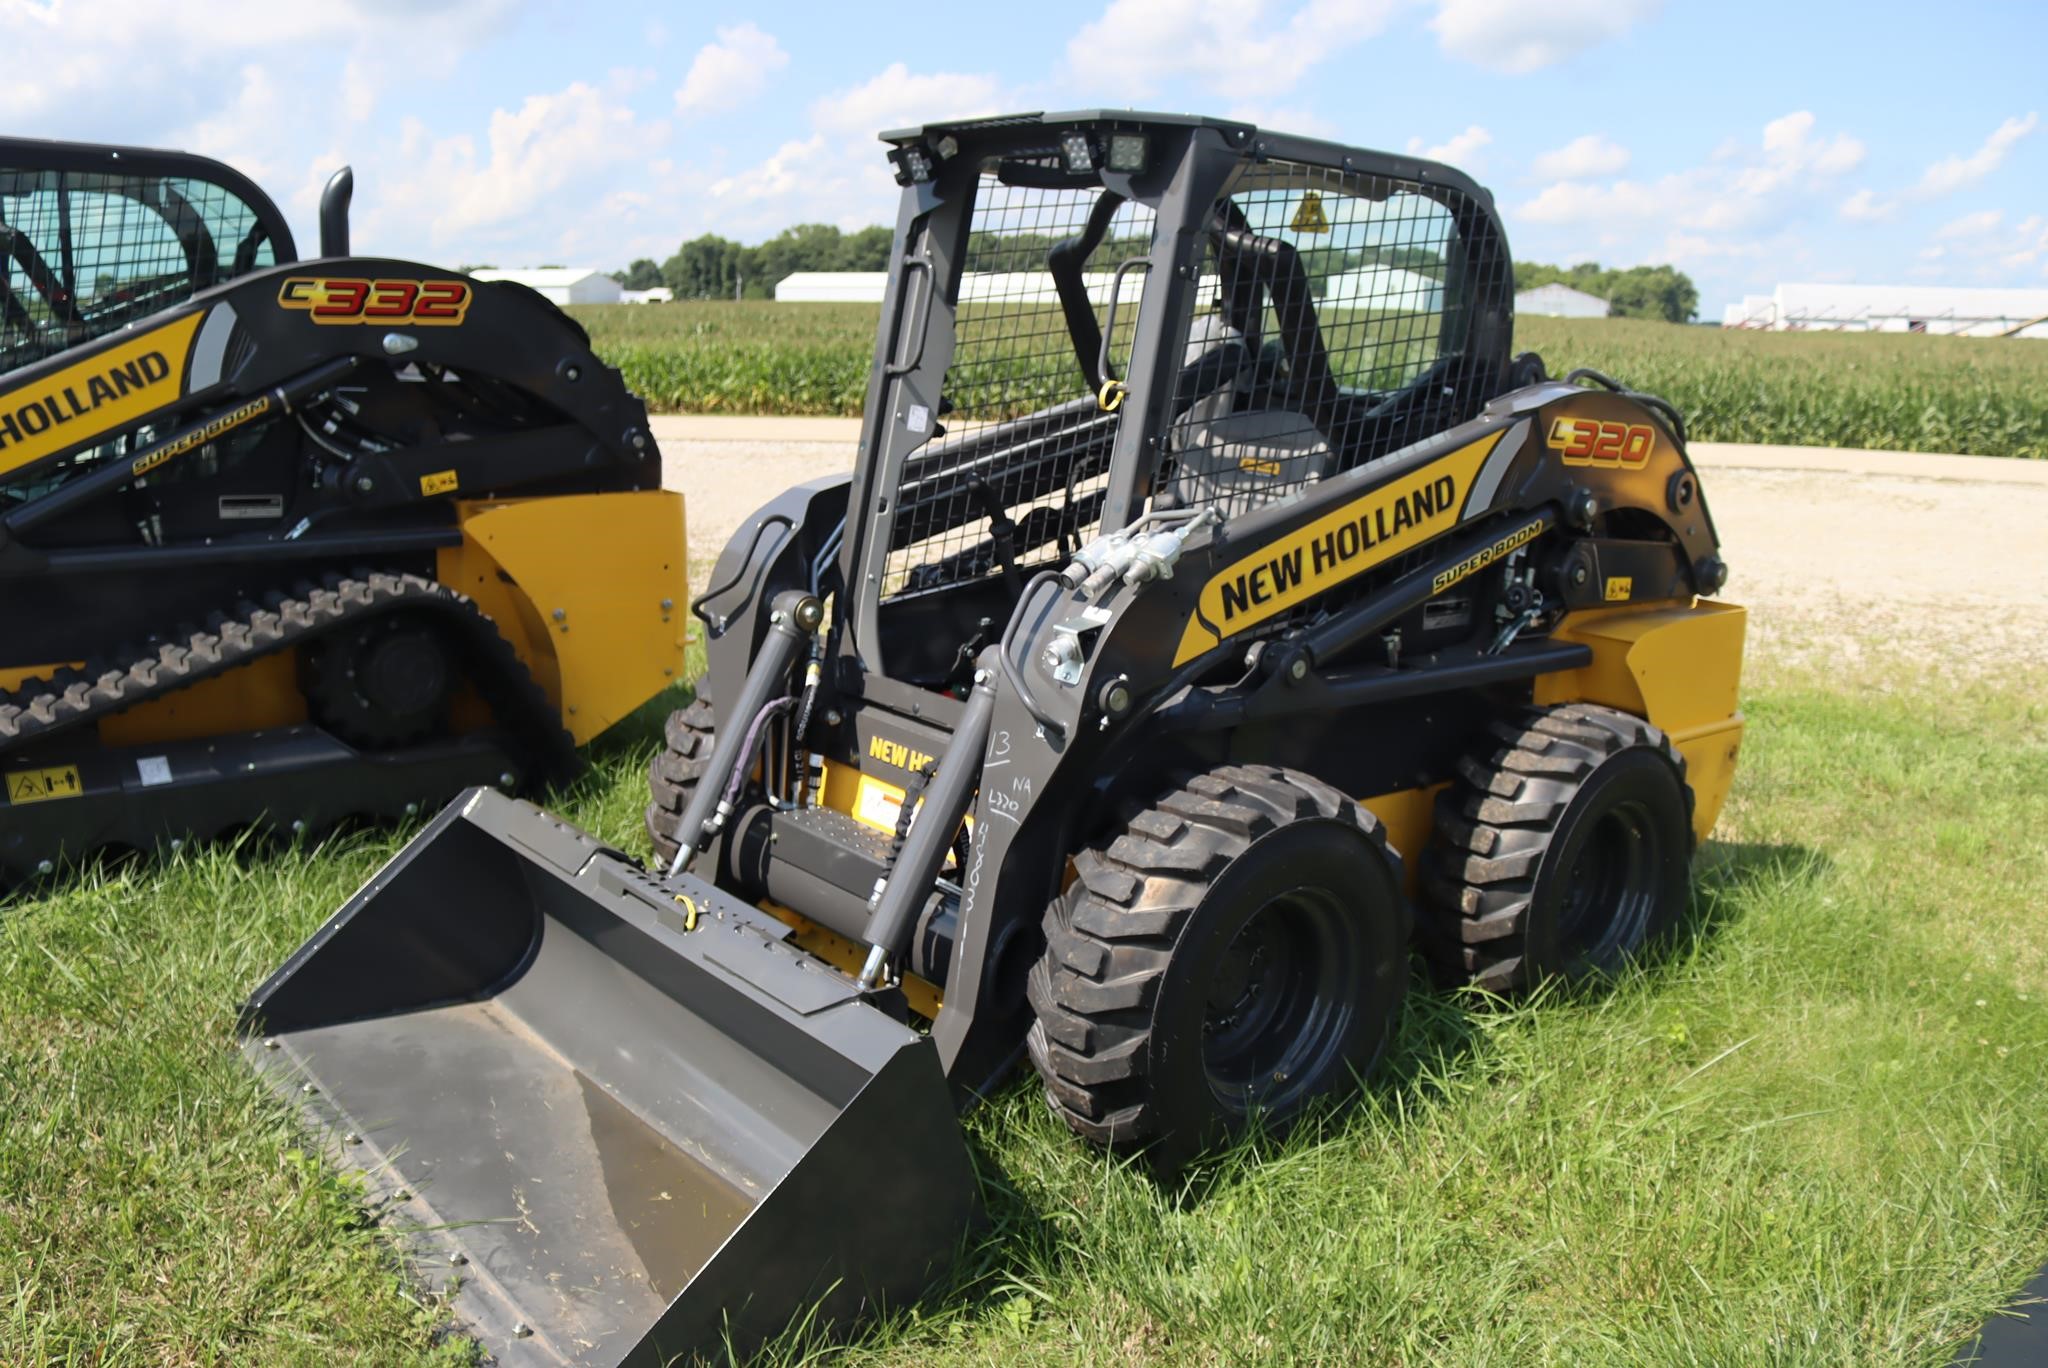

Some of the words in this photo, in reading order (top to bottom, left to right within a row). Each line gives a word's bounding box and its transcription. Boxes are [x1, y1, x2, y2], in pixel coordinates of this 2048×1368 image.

[279, 278, 472, 325] C332
[0, 352, 169, 448] HOLLAND
[133, 428, 206, 475] SUPER
[206, 396, 268, 438] BOOM
[1548, 417, 1655, 469] L320
[1221, 547, 1302, 621] NEW
[1311, 475, 1455, 576] HOLLAND
[1433, 548, 1492, 593] SUPER
[1493, 520, 1542, 559] BOOM
[869, 735, 908, 769] NEW
[988, 731, 1010, 758] 13
[1012, 776, 1031, 793] NA
